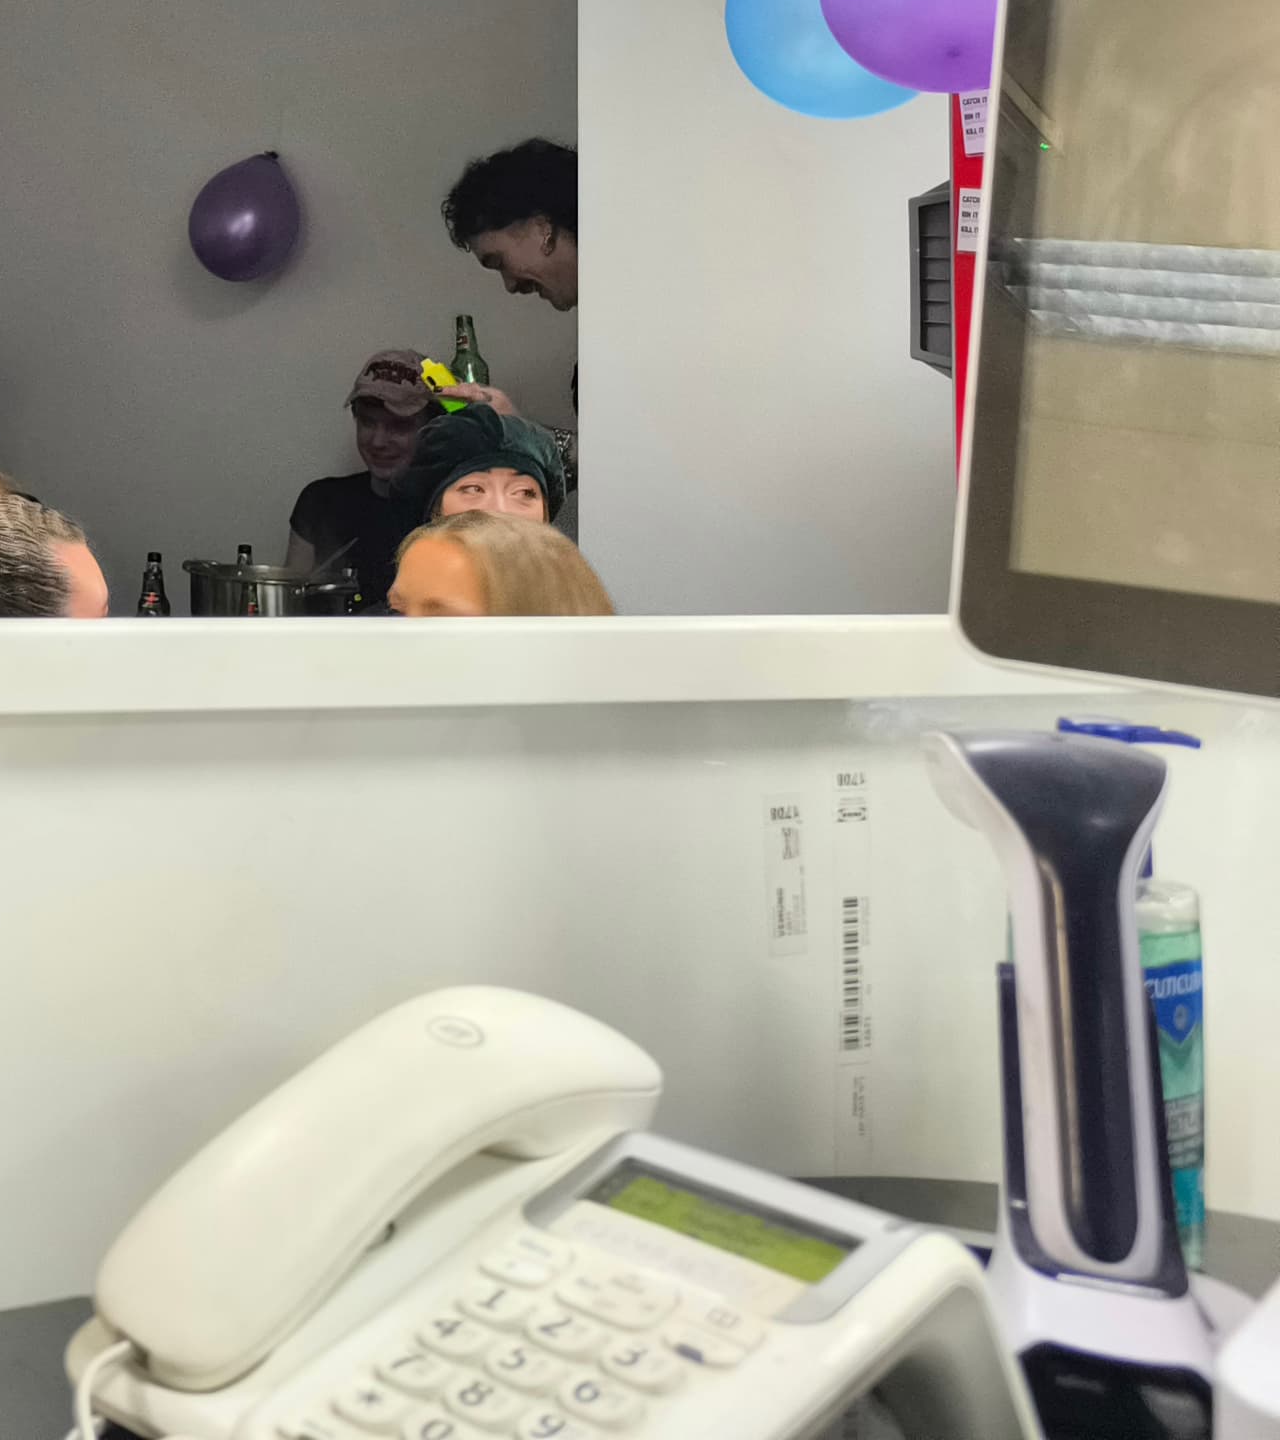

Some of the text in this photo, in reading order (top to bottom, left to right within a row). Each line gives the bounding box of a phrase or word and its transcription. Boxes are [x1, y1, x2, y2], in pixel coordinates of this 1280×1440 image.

[478, 1289, 505, 1309] 1
[433, 1317, 463, 1338] 4
[539, 1317, 574, 1338] 2
[497, 1348, 527, 1369] 5
[614, 1347, 643, 1367] 3
[457, 1381, 493, 1407] 8
[573, 1381, 600, 1403] 6
